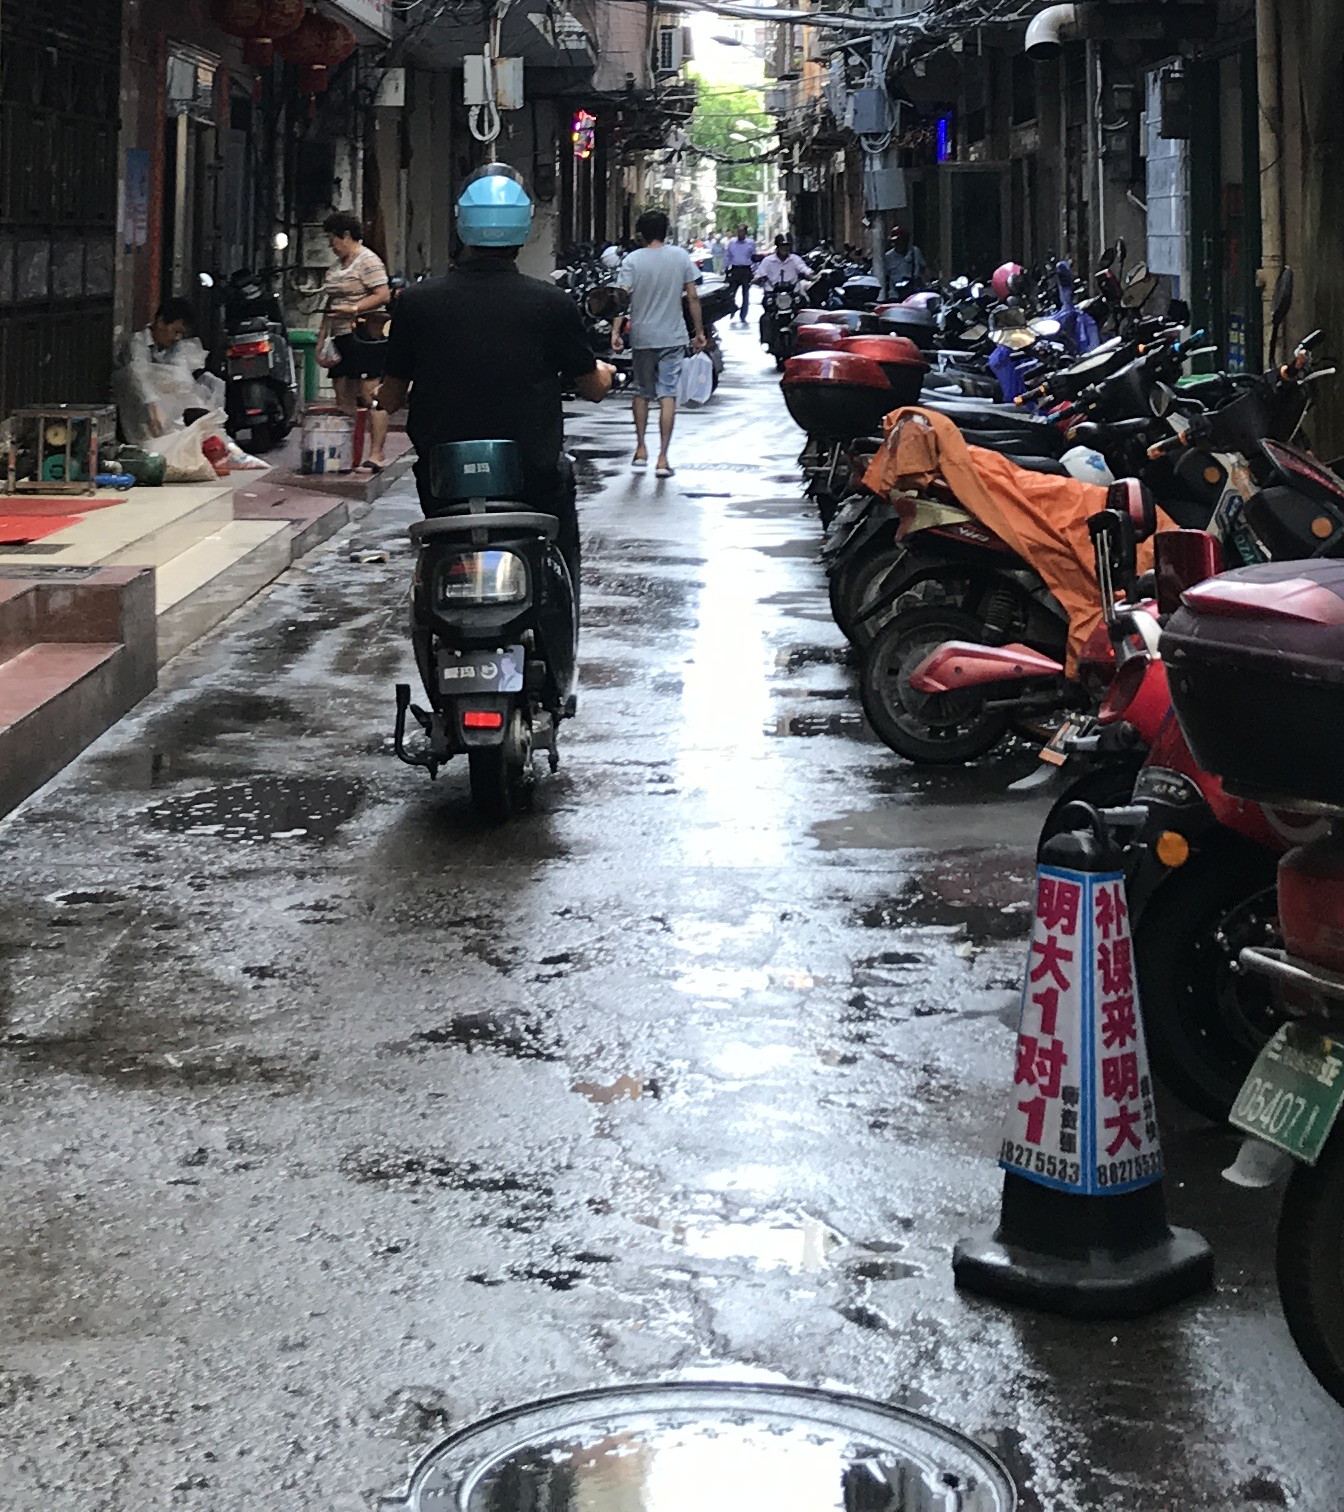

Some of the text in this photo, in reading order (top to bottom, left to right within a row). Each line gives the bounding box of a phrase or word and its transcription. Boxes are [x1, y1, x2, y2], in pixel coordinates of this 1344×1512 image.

[1014, 877, 1081, 1147] 明大1对1
[1094, 879, 1142, 1157] 补课来明大
